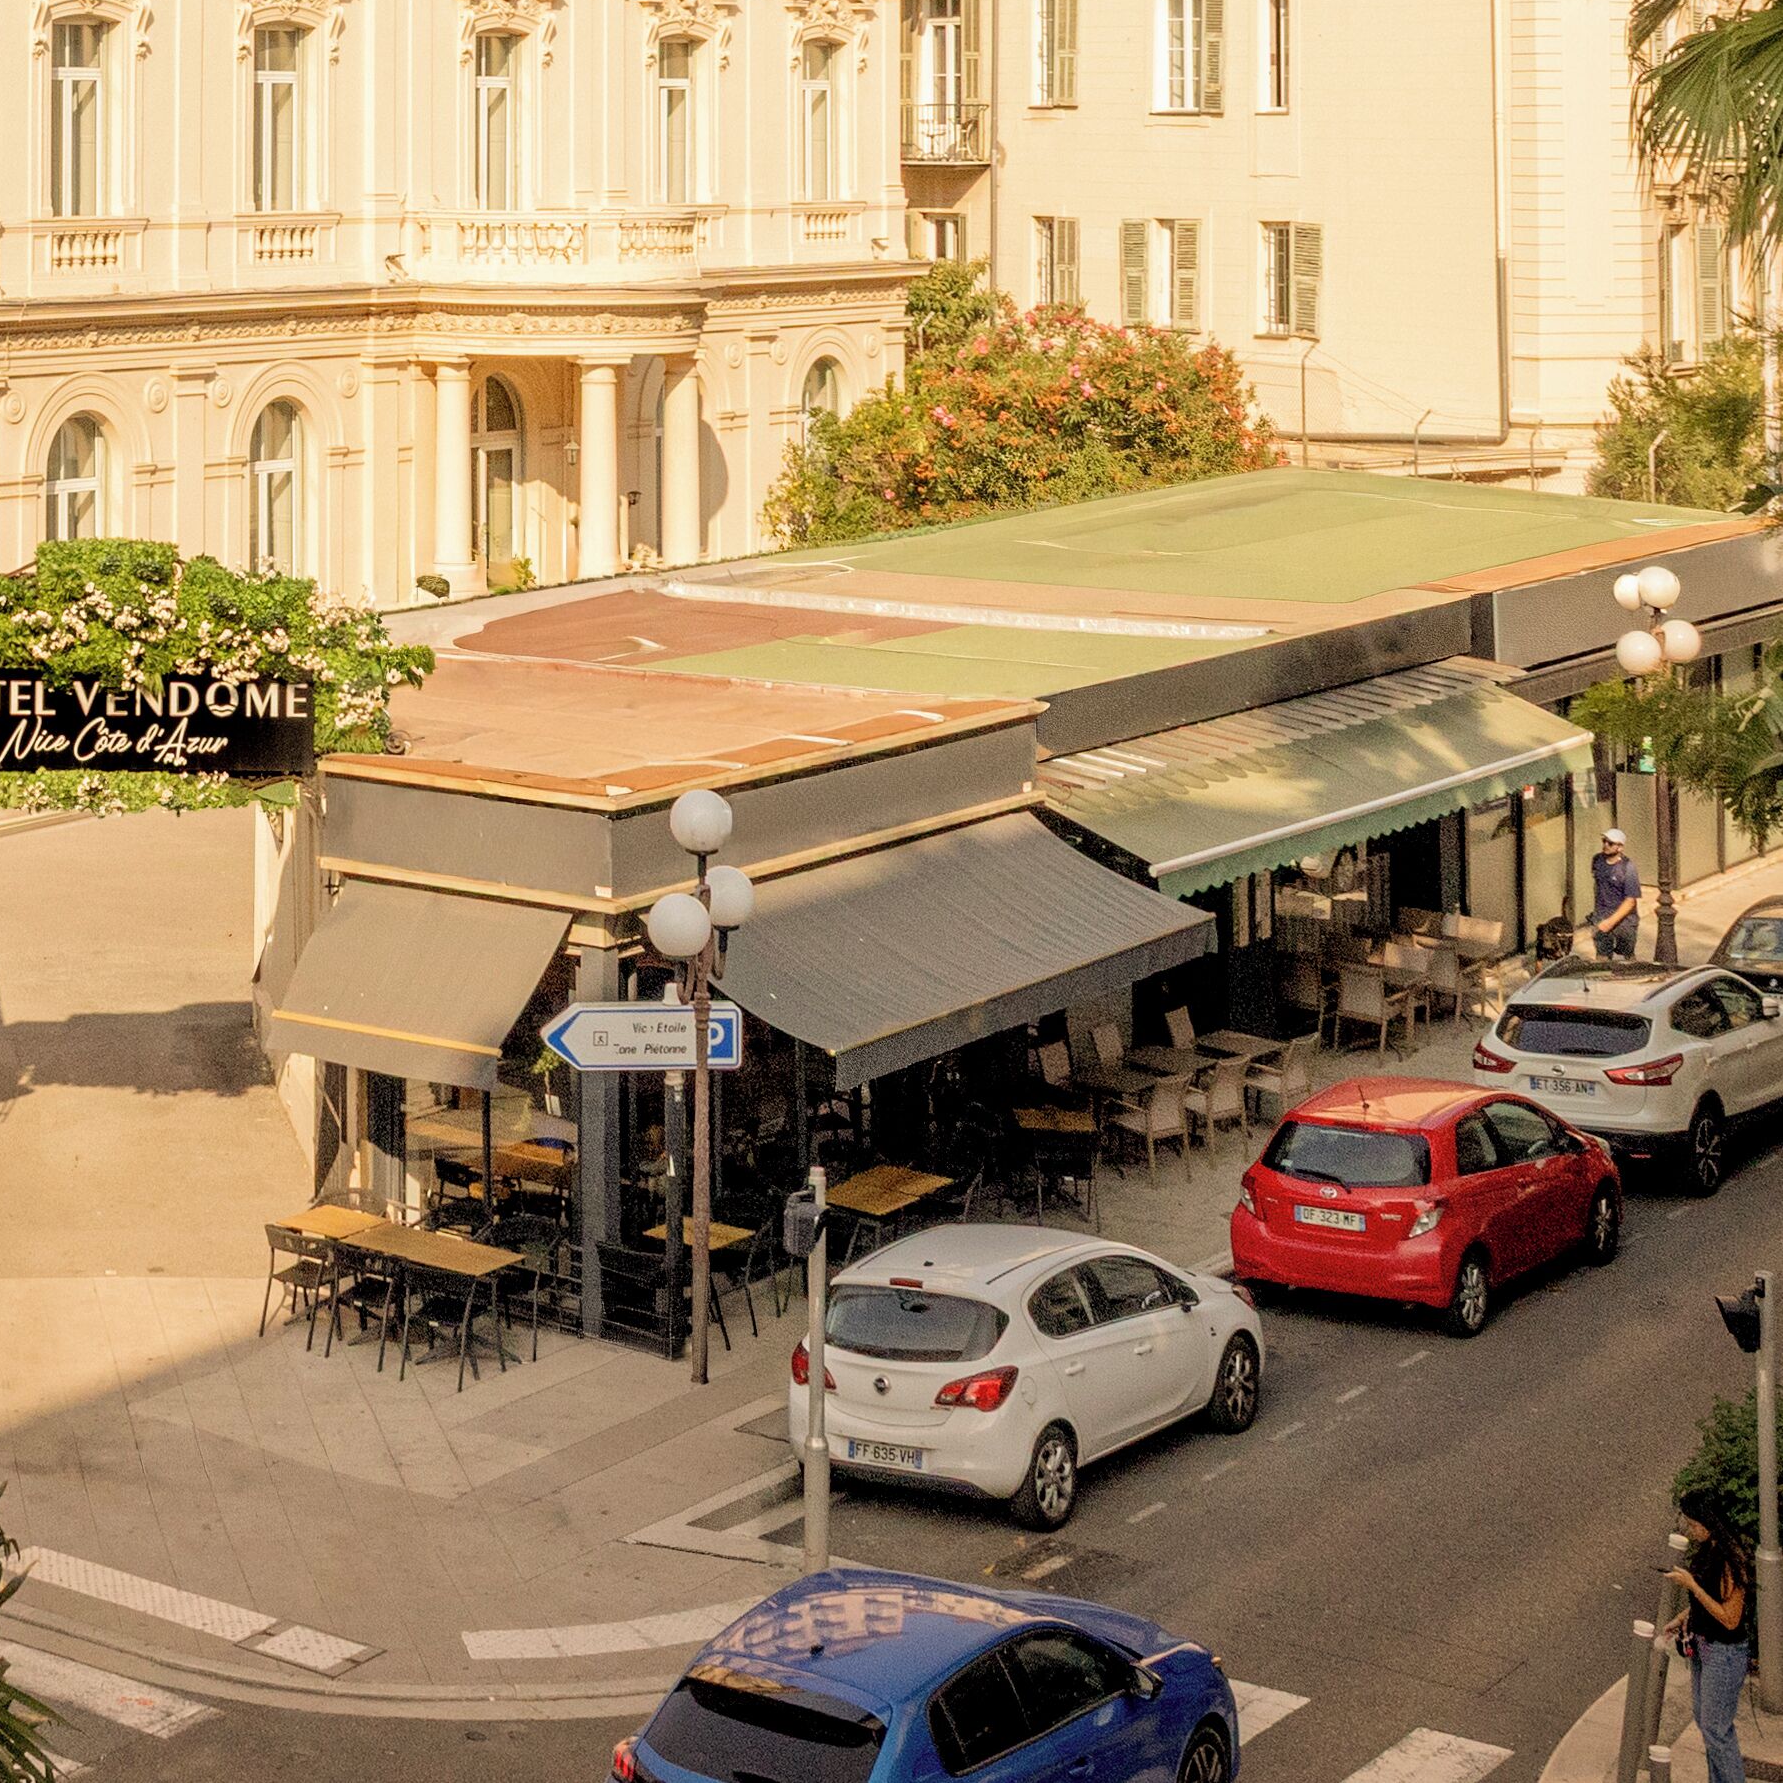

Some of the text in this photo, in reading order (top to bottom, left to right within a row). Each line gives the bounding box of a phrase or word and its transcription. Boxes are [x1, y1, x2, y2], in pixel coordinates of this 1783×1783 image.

[75, 681, 309, 718] VENDOME
[74, 717, 134, 761] Côte
[136, 717, 229, 761] d'Azur
[657, 1022, 687, 1033] Etoile
[644, 1043, 688, 1055] Piétonne
